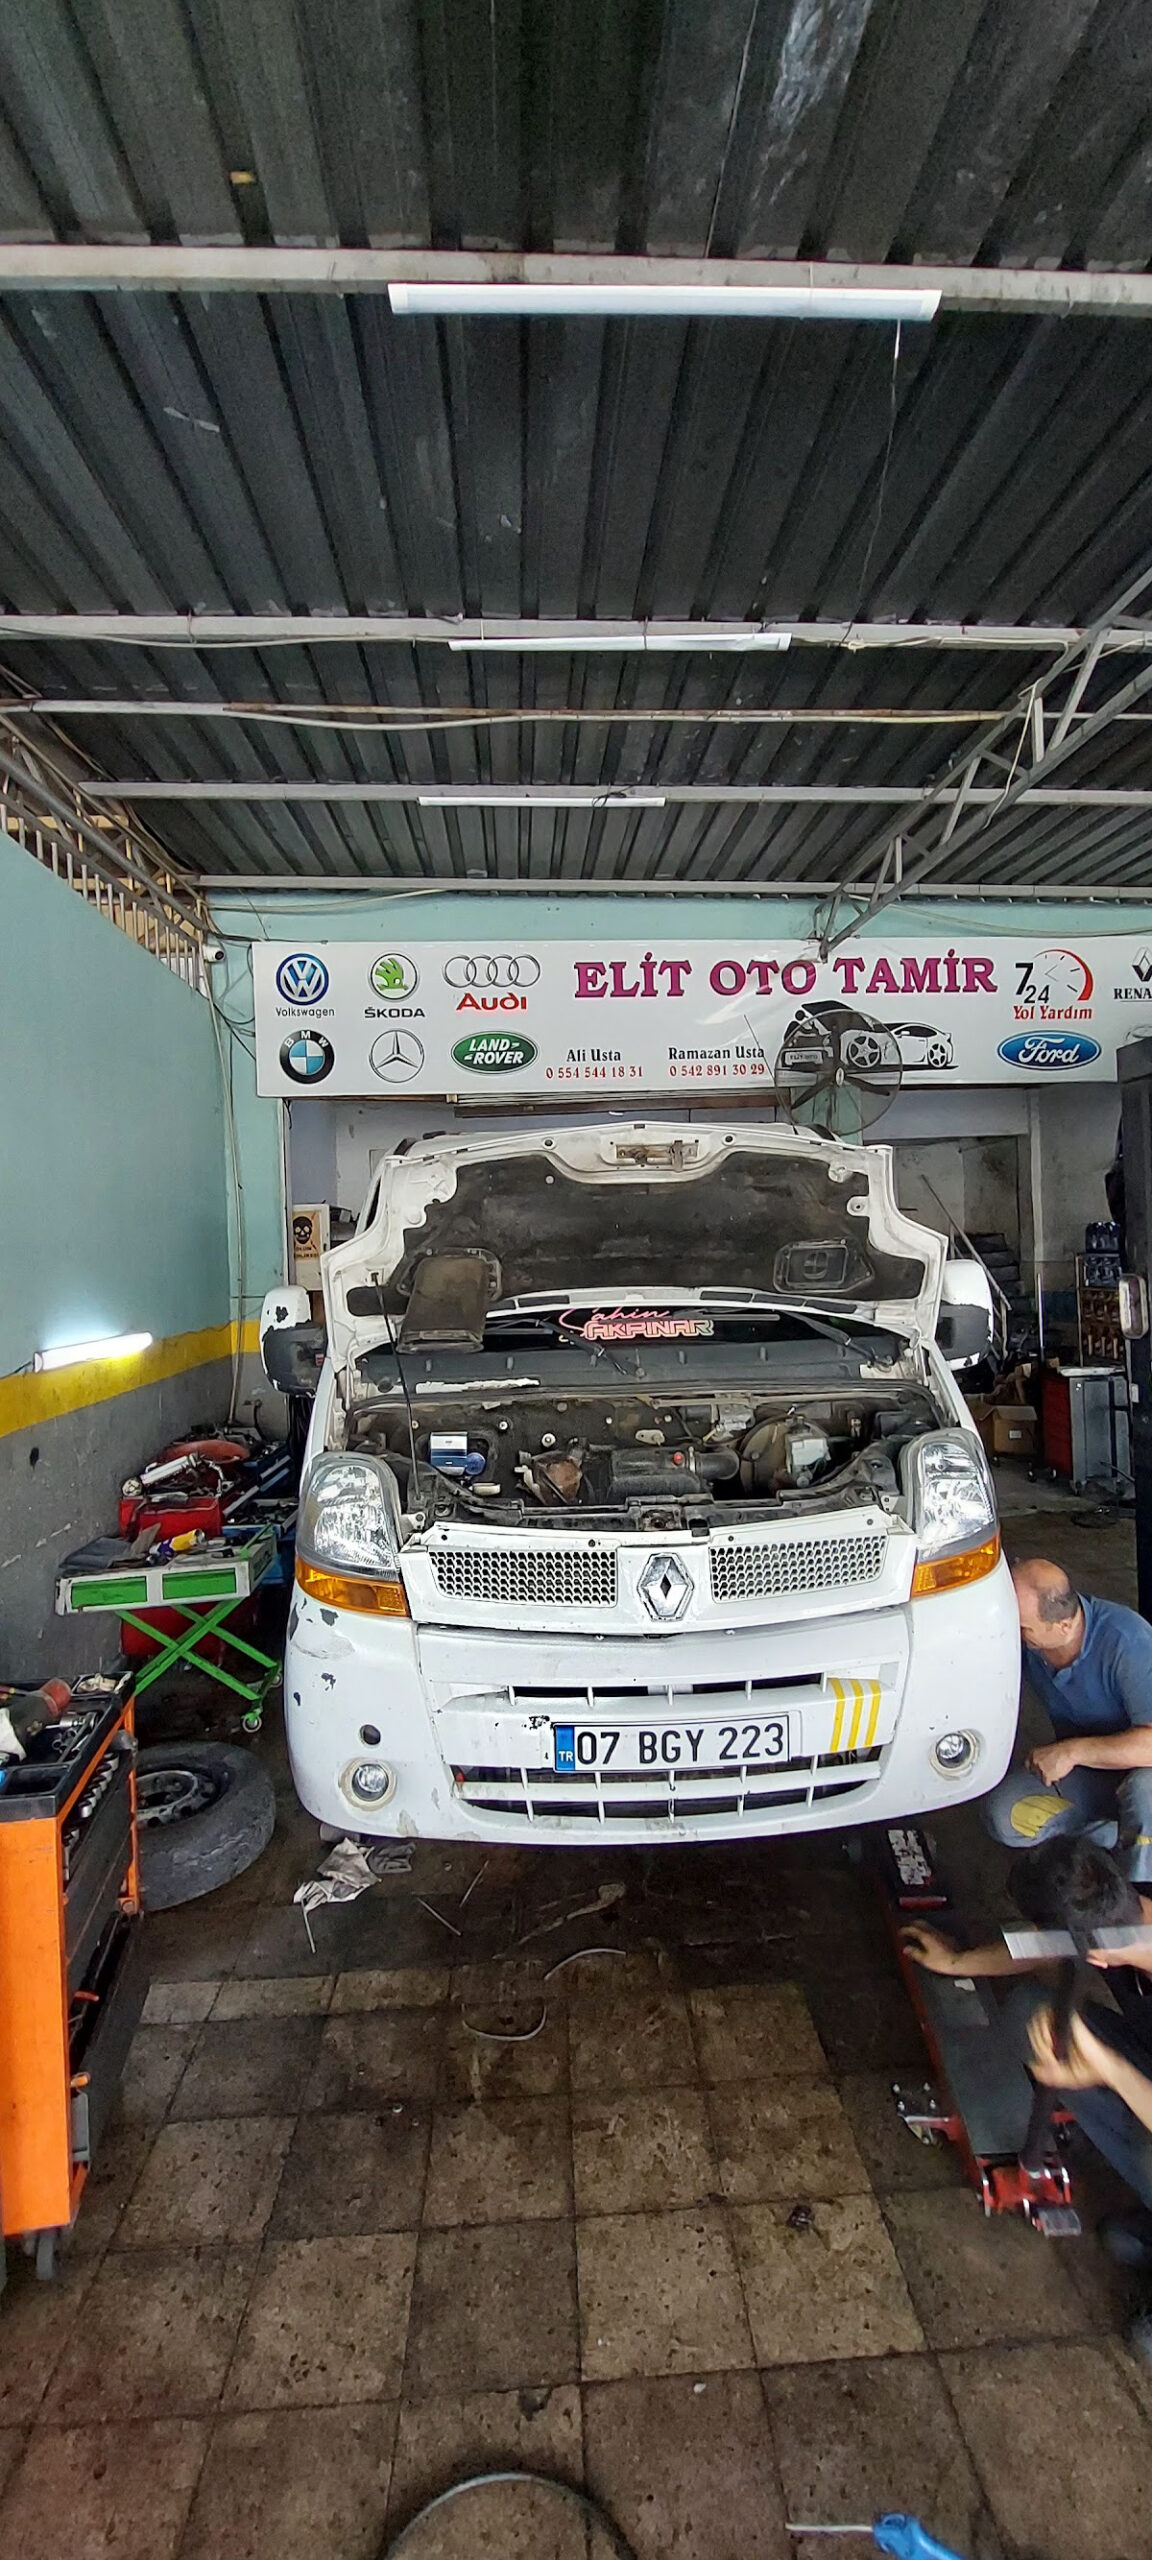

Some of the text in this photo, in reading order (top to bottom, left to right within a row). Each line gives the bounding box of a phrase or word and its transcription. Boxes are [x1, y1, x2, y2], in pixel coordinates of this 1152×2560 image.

[574, 949, 998, 998] ELİT OTO TAMİR
[1015, 962, 1034, 995] 7
[456, 992, 527, 1011] Audi
[1024, 985, 1050, 1004] 24
[275, 1007, 335, 1019] Volkswagen
[364, 1006, 426, 1019] ŠKODA
[1013, 1005, 1093, 1020] Yol Yardım
[284, 1030, 329, 1049] BMW
[468, 1038, 511, 1052] LAND
[472, 1050, 524, 1065] ROVER
[566, 1048, 621, 1063] Ali Usta
[668, 1046, 765, 1060] Ramazan Usta
[1018, 1036, 1081, 1064] Ford
[546, 1065, 643, 1079] 0 554 544 18 31
[669, 1063, 766, 1077] 0 542 891 30 29
[584, 1319, 714, 1341] AKPINAR
[558, 1722, 785, 1765] TR 07 BGY 223
